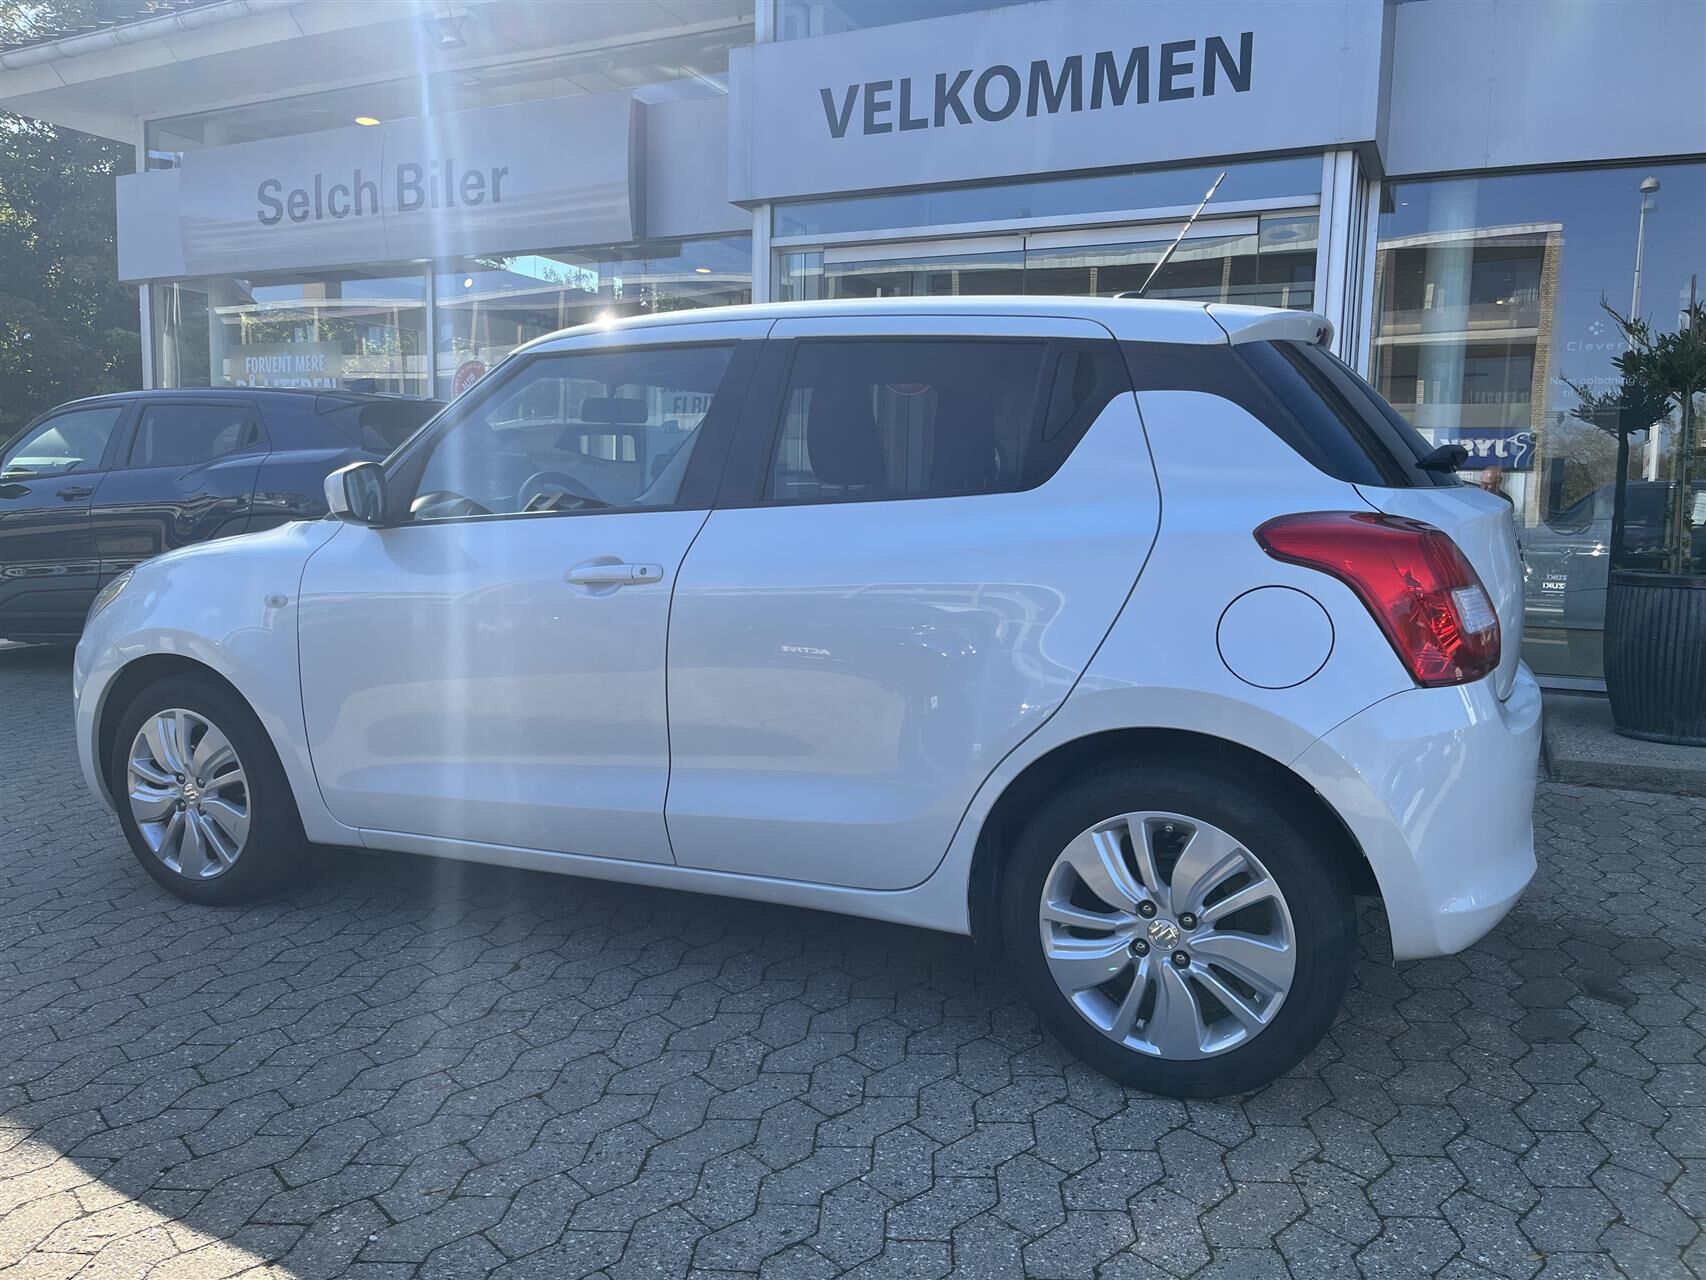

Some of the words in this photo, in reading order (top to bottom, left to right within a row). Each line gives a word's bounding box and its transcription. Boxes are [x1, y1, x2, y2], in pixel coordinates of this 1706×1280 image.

[820, 31, 1254, 138] VELKOMMEN
[257, 168, 379, 226] Selch
[396, 158, 510, 213] Biler
[245, 355, 292, 374] FORVENT
[295, 354, 326, 372] MERE
[1566, 341, 1624, 351] Clever
